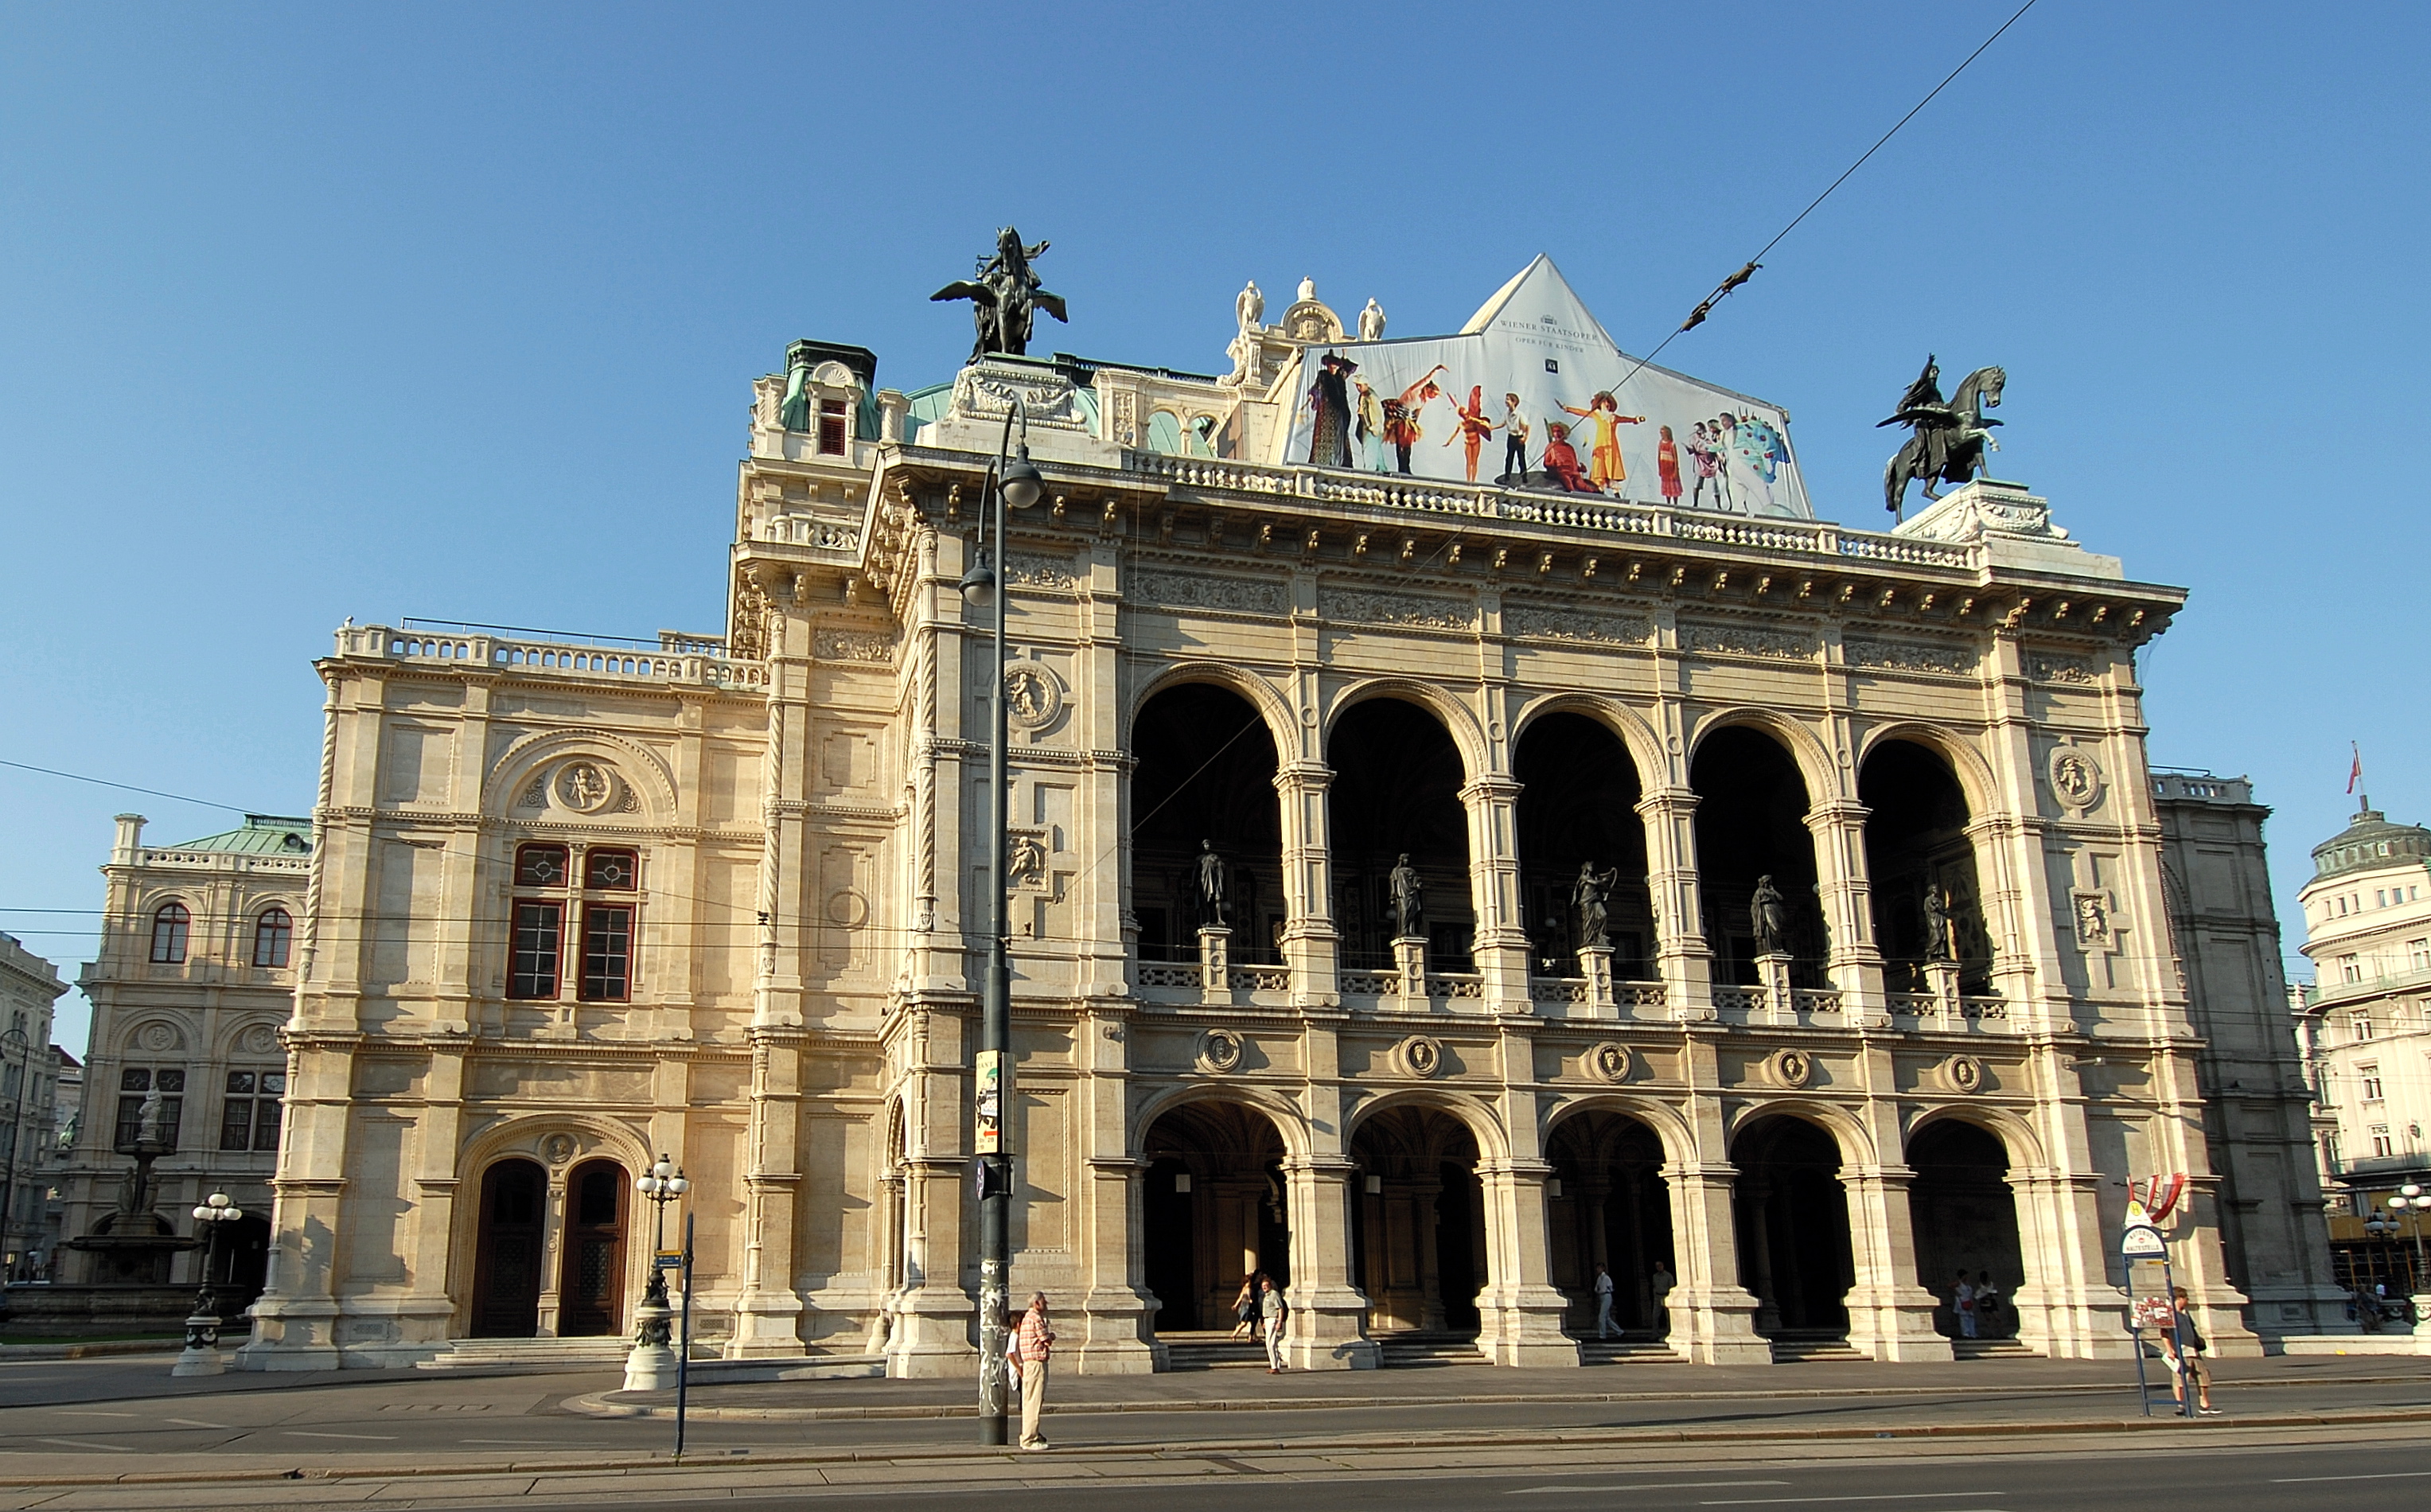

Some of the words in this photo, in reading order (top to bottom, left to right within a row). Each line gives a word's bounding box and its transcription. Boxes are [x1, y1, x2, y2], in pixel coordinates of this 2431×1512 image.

[1500, 320, 1537, 330] WIENER
[1541, 325, 1598, 341] STAATSOPER
[1538, 339, 1553, 349] FÜR
[1556, 343, 1584, 353] KINDER
